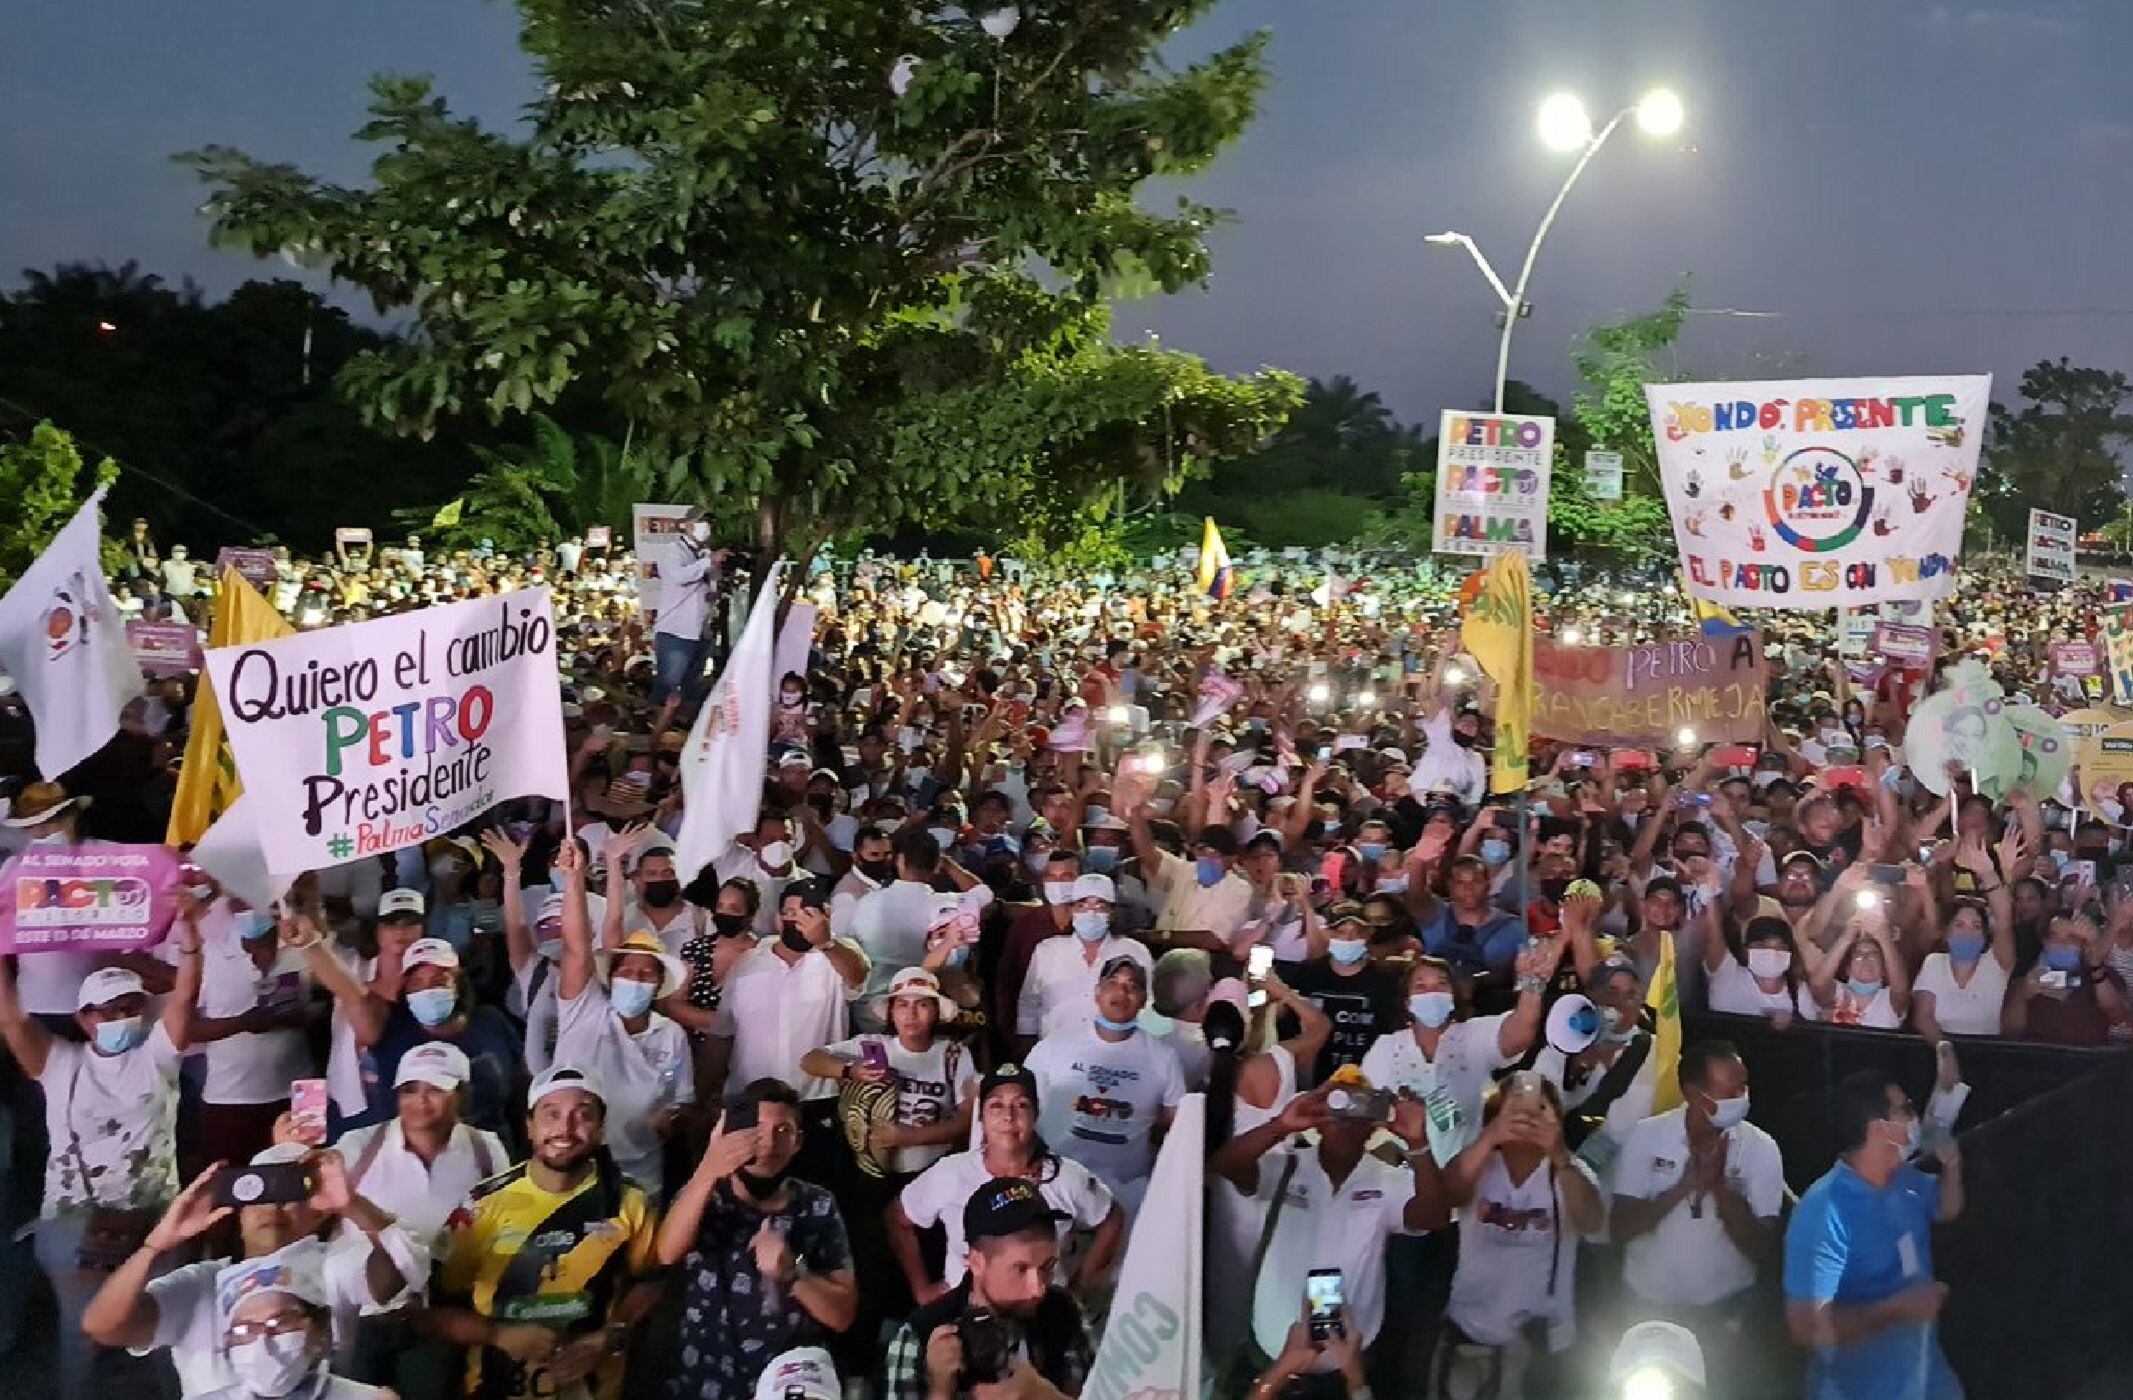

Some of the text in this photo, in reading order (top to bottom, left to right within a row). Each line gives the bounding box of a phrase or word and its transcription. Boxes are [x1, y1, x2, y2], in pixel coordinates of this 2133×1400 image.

[1449, 416, 1542, 448] PETRO
[1446, 464, 1538, 496] PACTO
[1782, 480, 1852, 510] PACTO
[1443, 513, 1534, 543] PALMA
[1688, 554, 1715, 588] EL
[1720, 559, 1790, 593] PACTO
[1799, 560, 1840, 591] ES
[229, 601, 549, 723] Quiero el cambio
[1626, 641, 1715, 690] PETRO
[1730, 634, 1754, 669] A
[321, 684, 494, 777] PETRO
[302, 738, 492, 837] Presidente
[17, 878, 147, 909] PACTO
[1334, 1031, 1367, 1046] PLE
